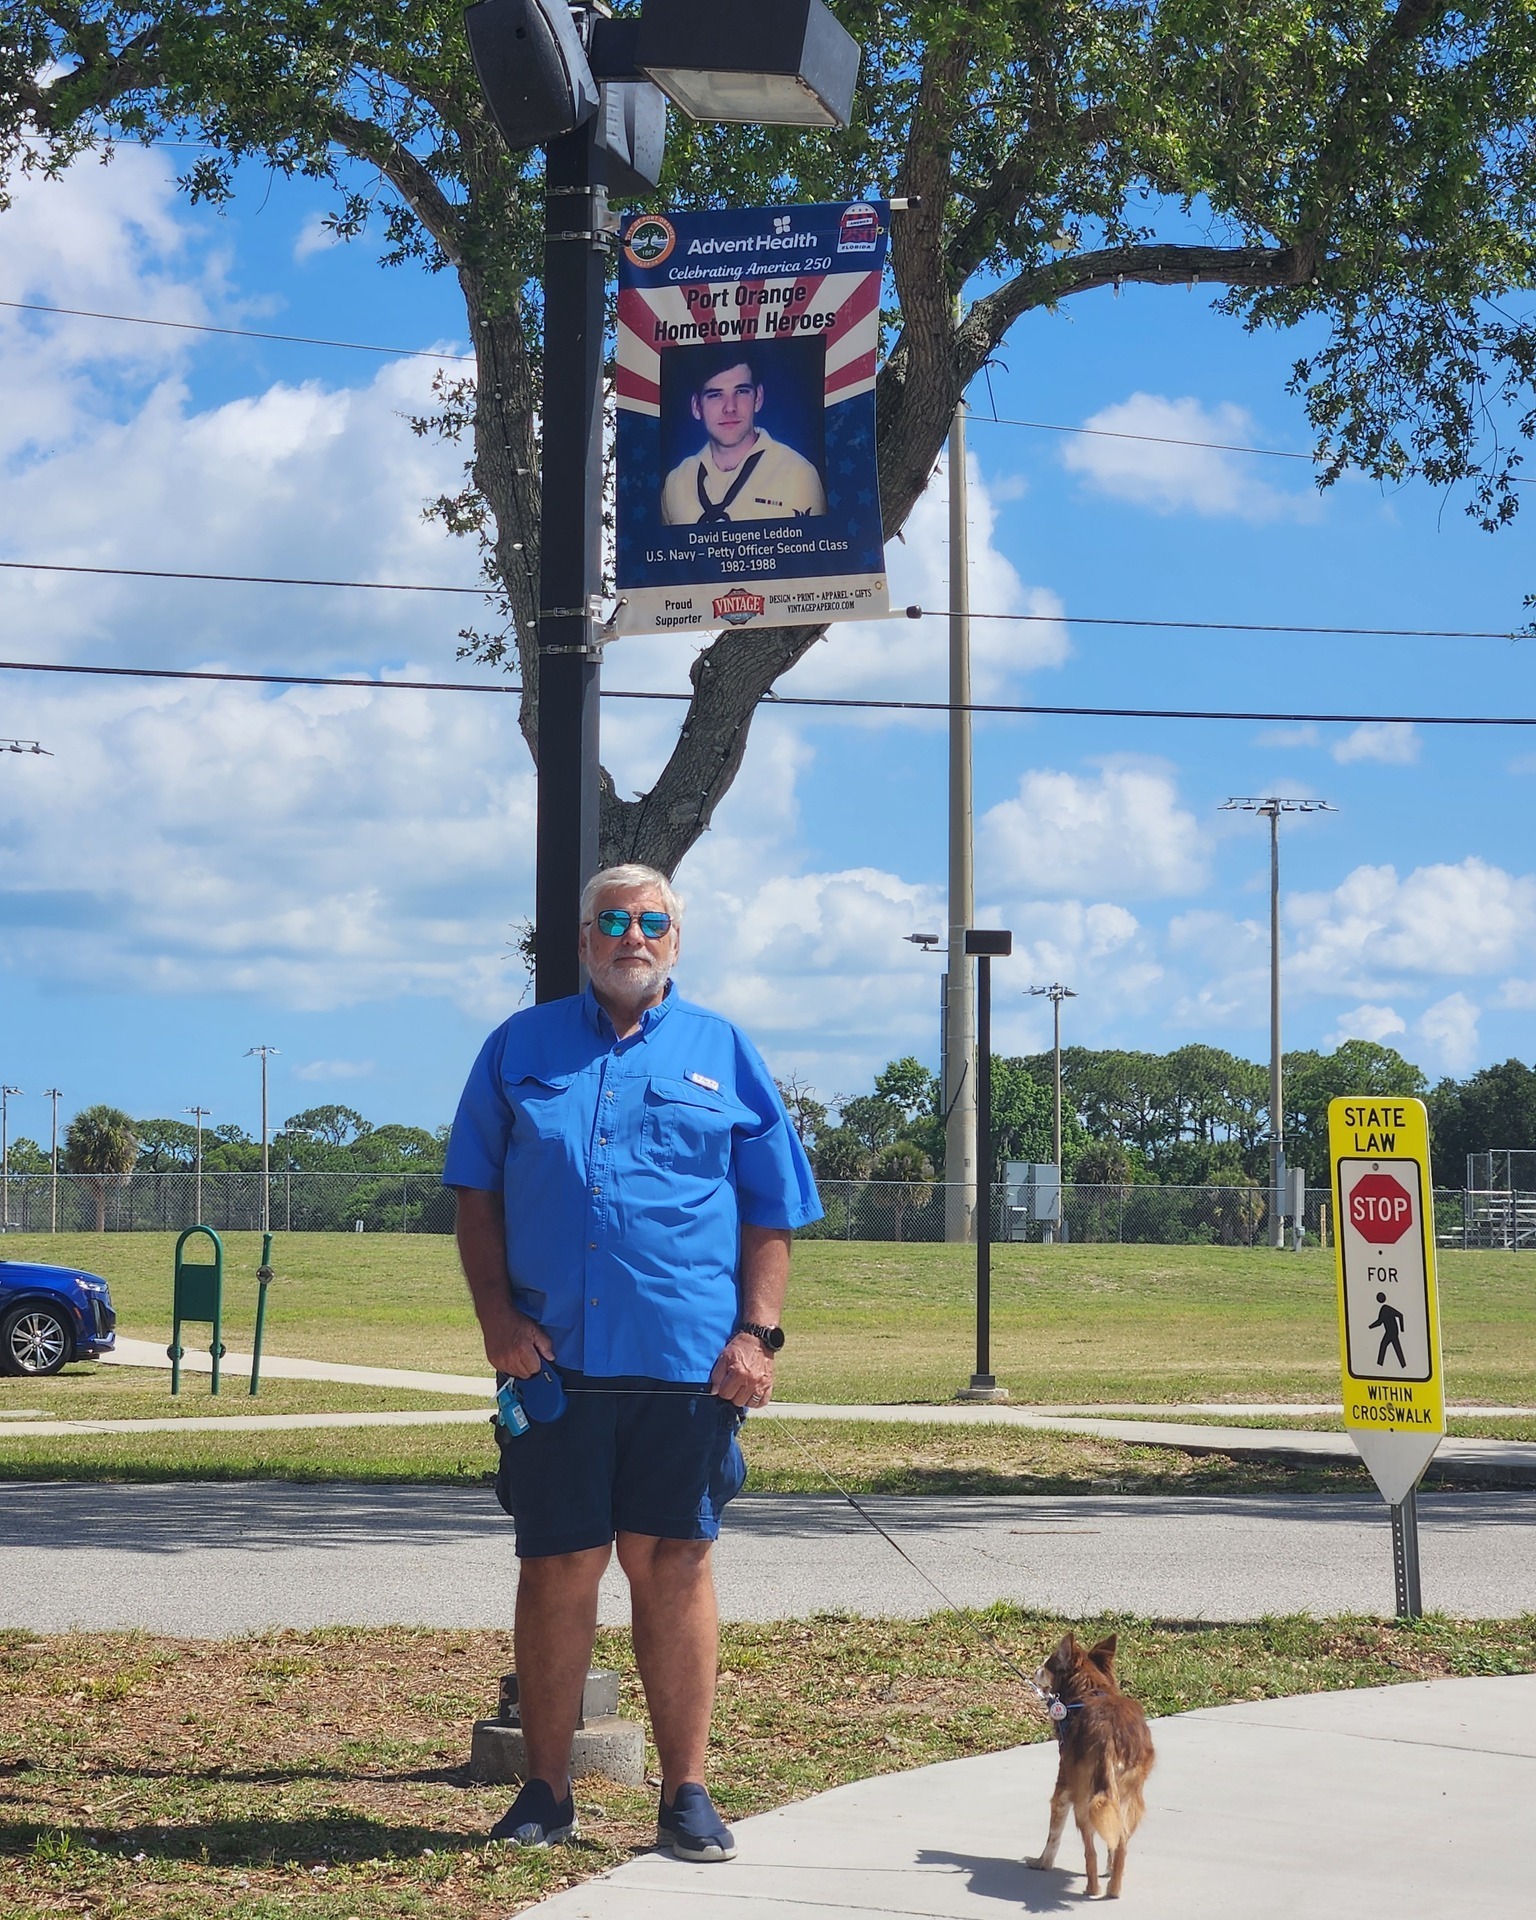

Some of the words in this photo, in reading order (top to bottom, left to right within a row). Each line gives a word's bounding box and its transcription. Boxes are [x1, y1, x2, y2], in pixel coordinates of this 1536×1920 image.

[687, 232, 818, 255] AdventHealth
[668, 264, 743, 281] Celebrating
[746, 260, 801, 275] America
[803, 256, 832, 271] 250
[687, 288, 729, 310] Port
[735, 285, 807, 309] Orange
[654, 316, 759, 342] Hometown
[765, 311, 836, 332] Heroes
[689, 531, 719, 545] David
[722, 530, 761, 545] Eugene
[764, 527, 803, 541] Leddon
[646, 551, 667, 562] U.S.
[669, 549, 696, 563] Navy
[708, 547, 735, 560] Petty
[738, 544, 774, 557] Officer
[777, 541, 815, 555] Second
[818, 539, 848, 552] Class
[720, 558, 777, 573] 1982-1988
[665, 599, 693, 611] Proud
[715, 596, 761, 613] VINTAGE
[769, 594, 792, 604] DESIGN
[797, 592, 815, 602] PRINT
[821, 590, 848, 601] APPAREL
[855, 589, 872, 599] GIFTS
[787, 602, 855, 613] VINTAGEPAPERCO.COM
[655, 613, 702, 627] Supporter
[1345, 1107, 1406, 1127] STATE
[1355, 1133, 1396, 1152] LAW
[1353, 1197, 1408, 1222] STOP
[1368, 1267, 1398, 1283] FOR
[1368, 1385, 1413, 1402] WITHIN
[1352, 1404, 1432, 1424] CROSSWALK
